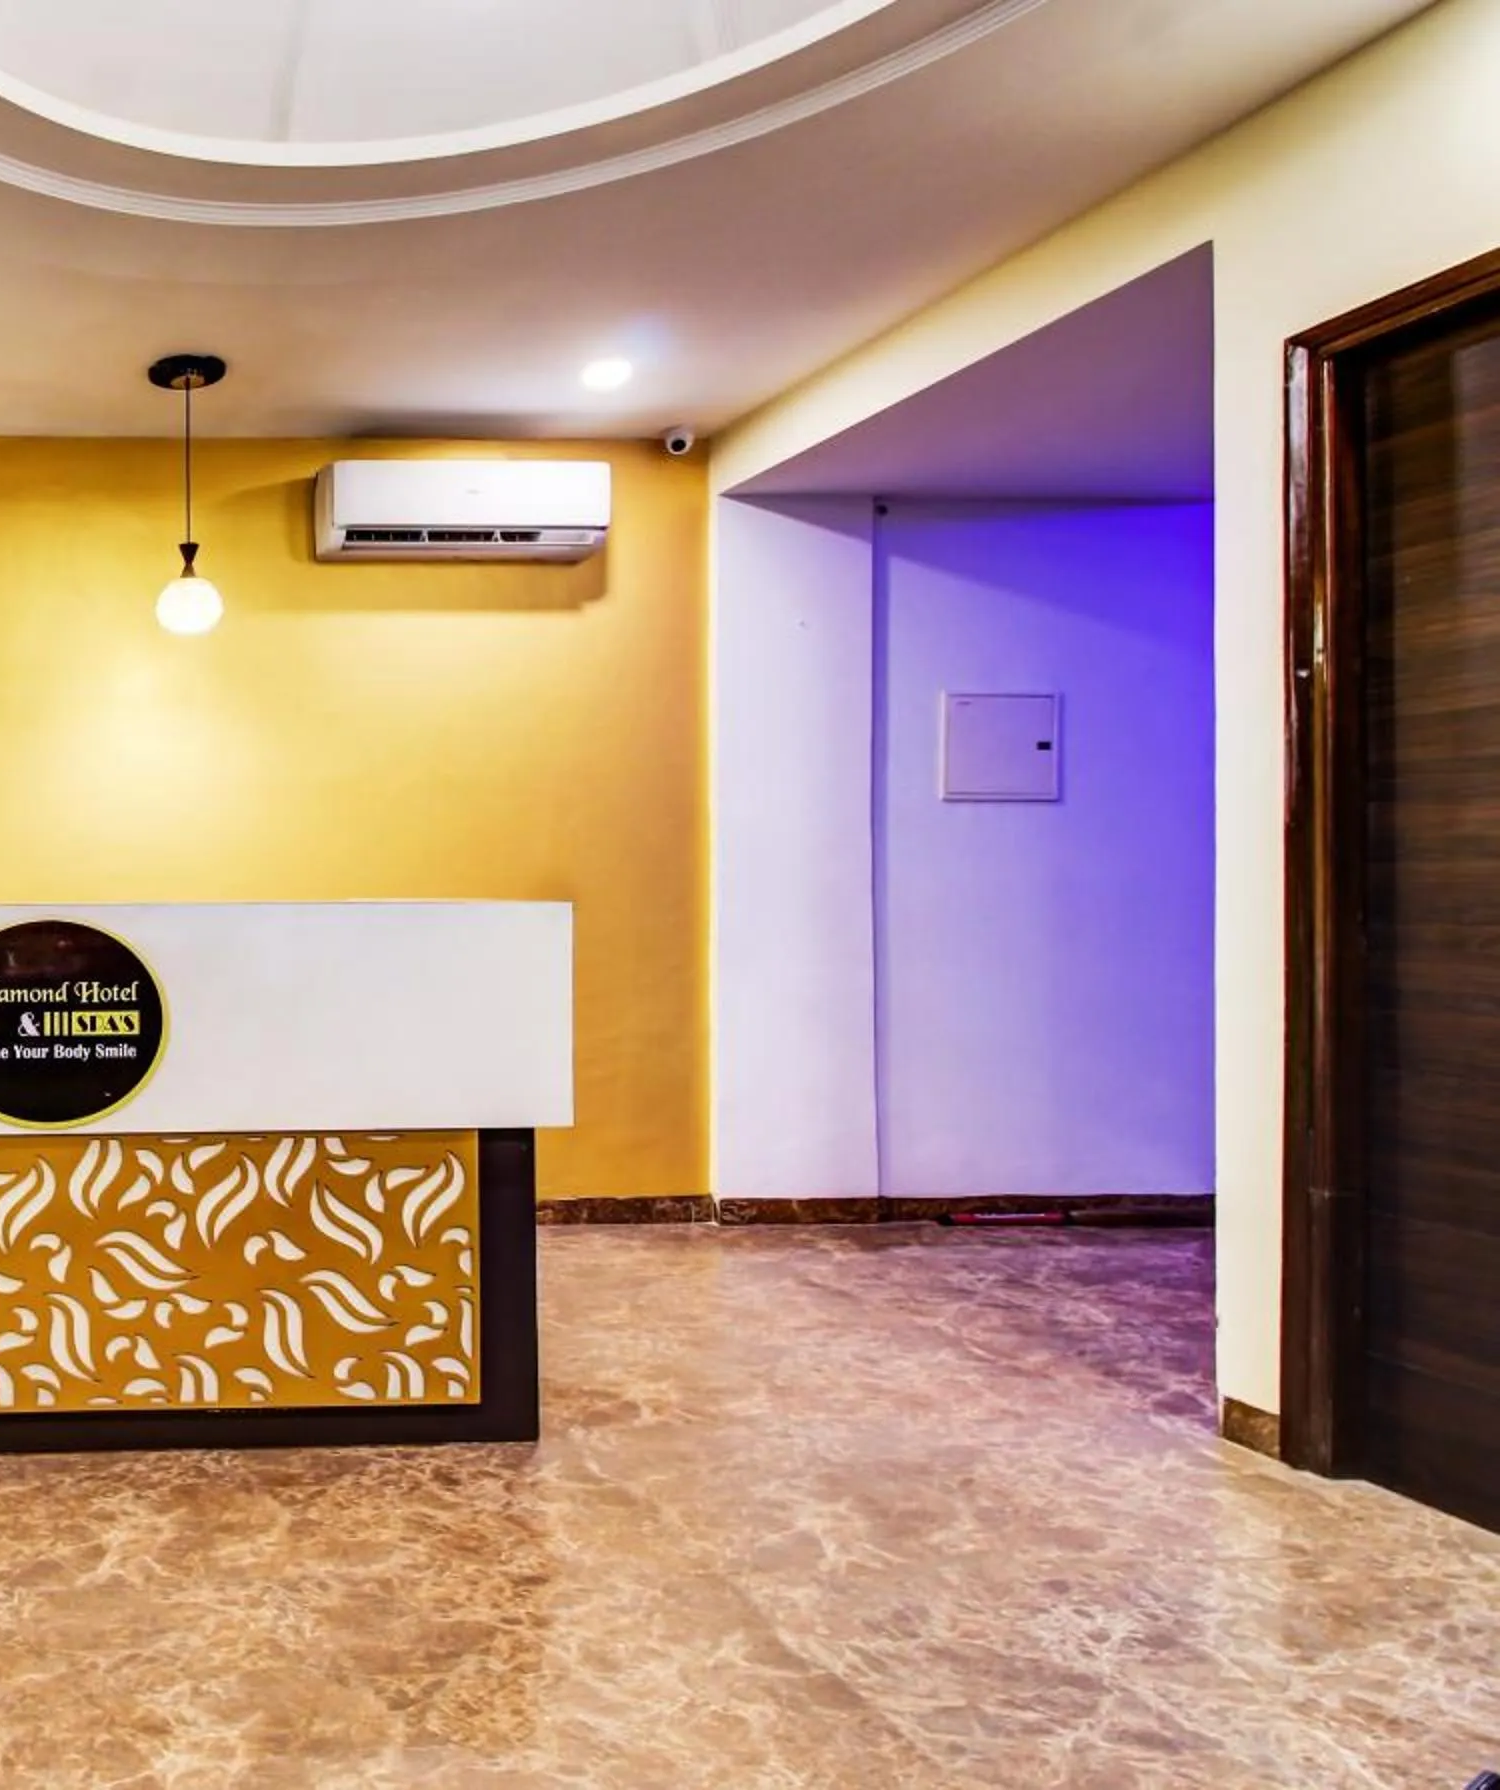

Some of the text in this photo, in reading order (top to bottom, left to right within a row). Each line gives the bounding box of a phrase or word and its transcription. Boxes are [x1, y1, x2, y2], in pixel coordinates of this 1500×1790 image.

[74, 981, 139, 1003] Hotel
[18, 1012, 40, 1036] &
[13, 1044, 48, 1059] Your
[53, 1043, 90, 1061] Body
[95, 1042, 137, 1058] Smile
